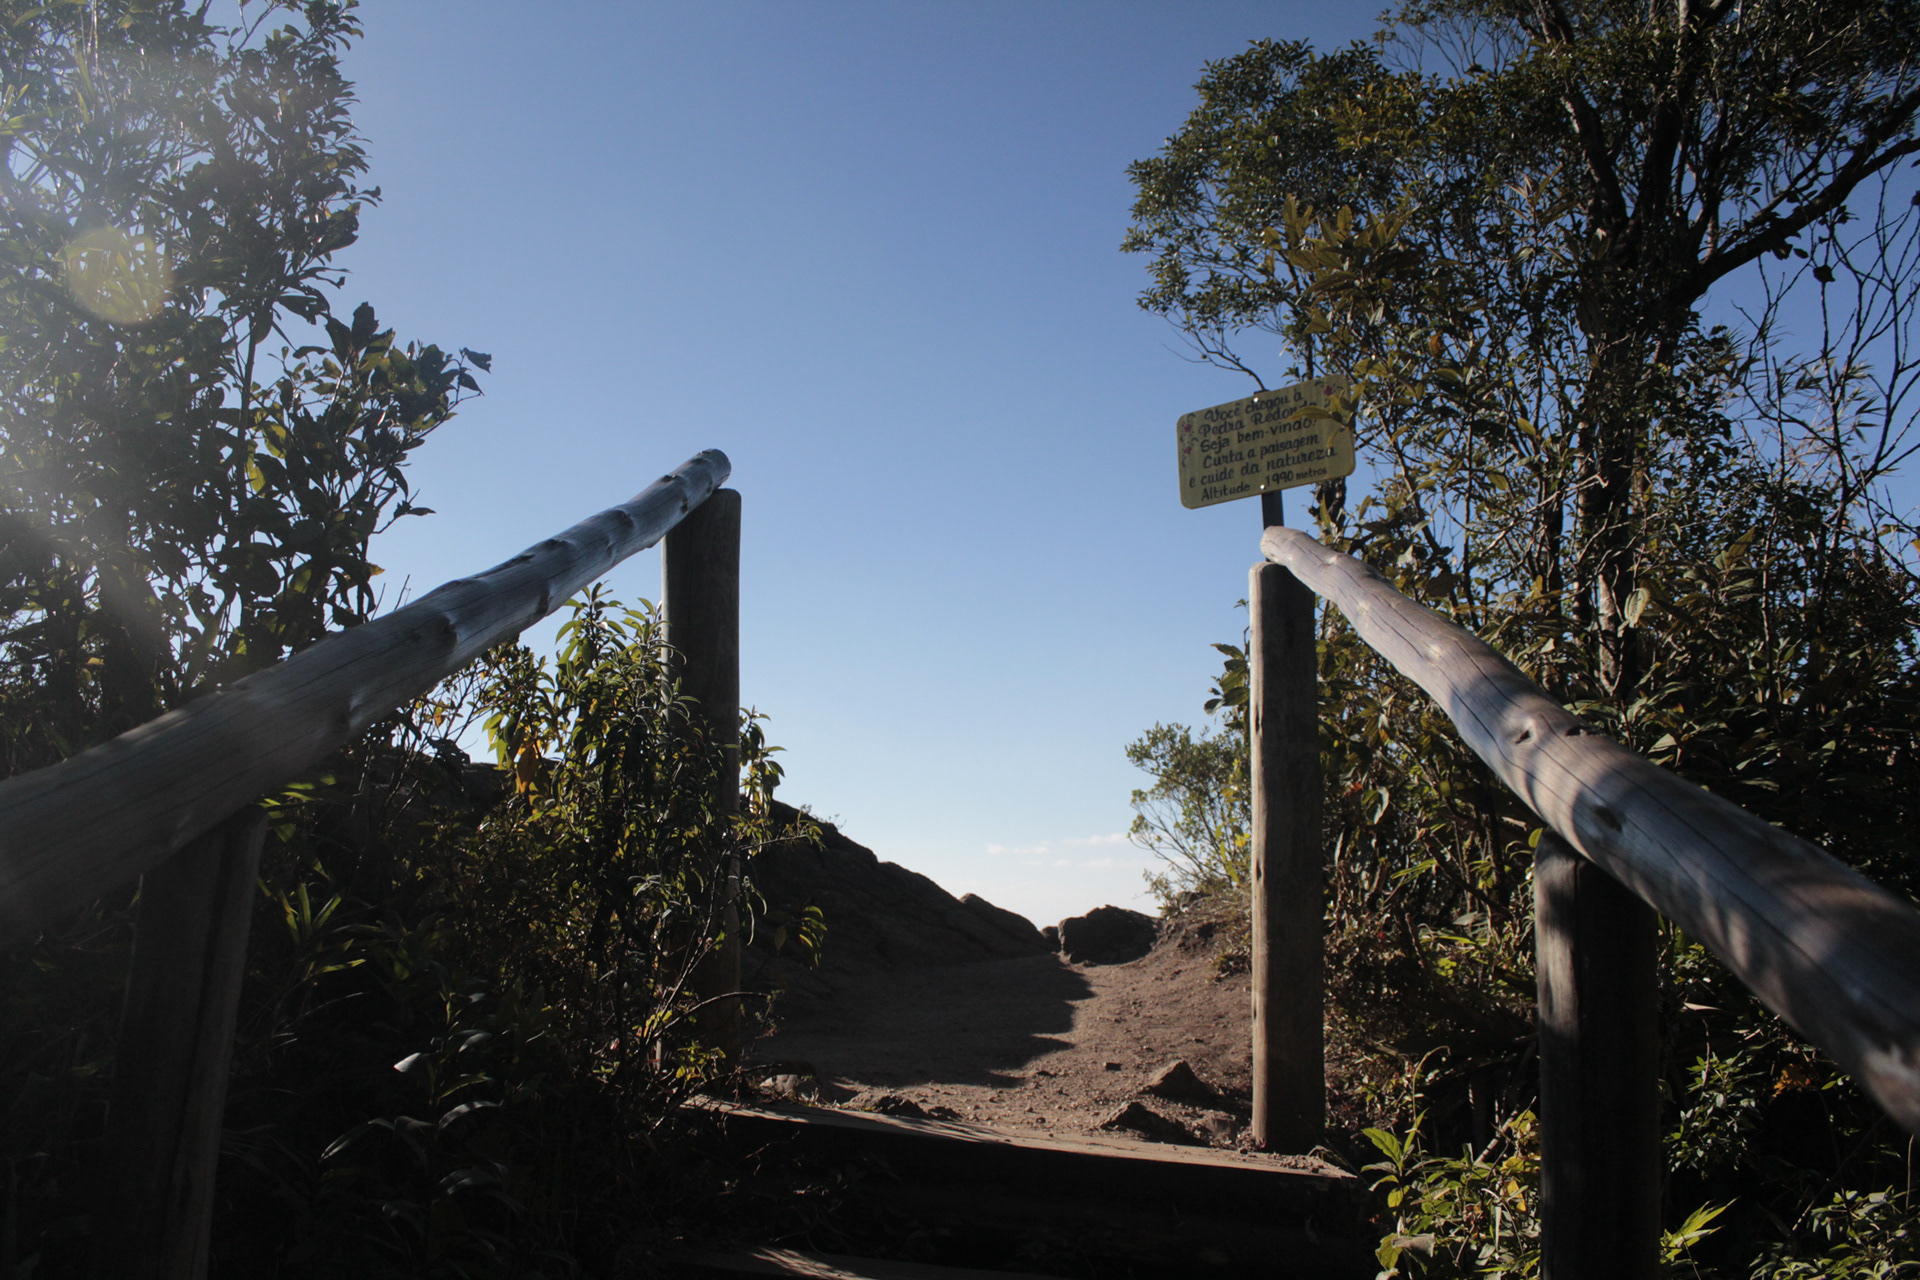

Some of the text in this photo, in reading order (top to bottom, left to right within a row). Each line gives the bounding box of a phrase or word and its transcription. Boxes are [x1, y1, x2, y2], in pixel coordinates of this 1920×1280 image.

[1198, 400, 1317, 437] Pedra Redon
[1204, 403, 1240, 423] Você
[1245, 395, 1290, 413] chegou
[1200, 437, 1230, 454] Seja
[1203, 433, 1319, 468] Curta a paisagem
[1189, 446, 1336, 488] e cuide da natureza
[1201, 468, 1327, 501] Altitude 1990 metros
